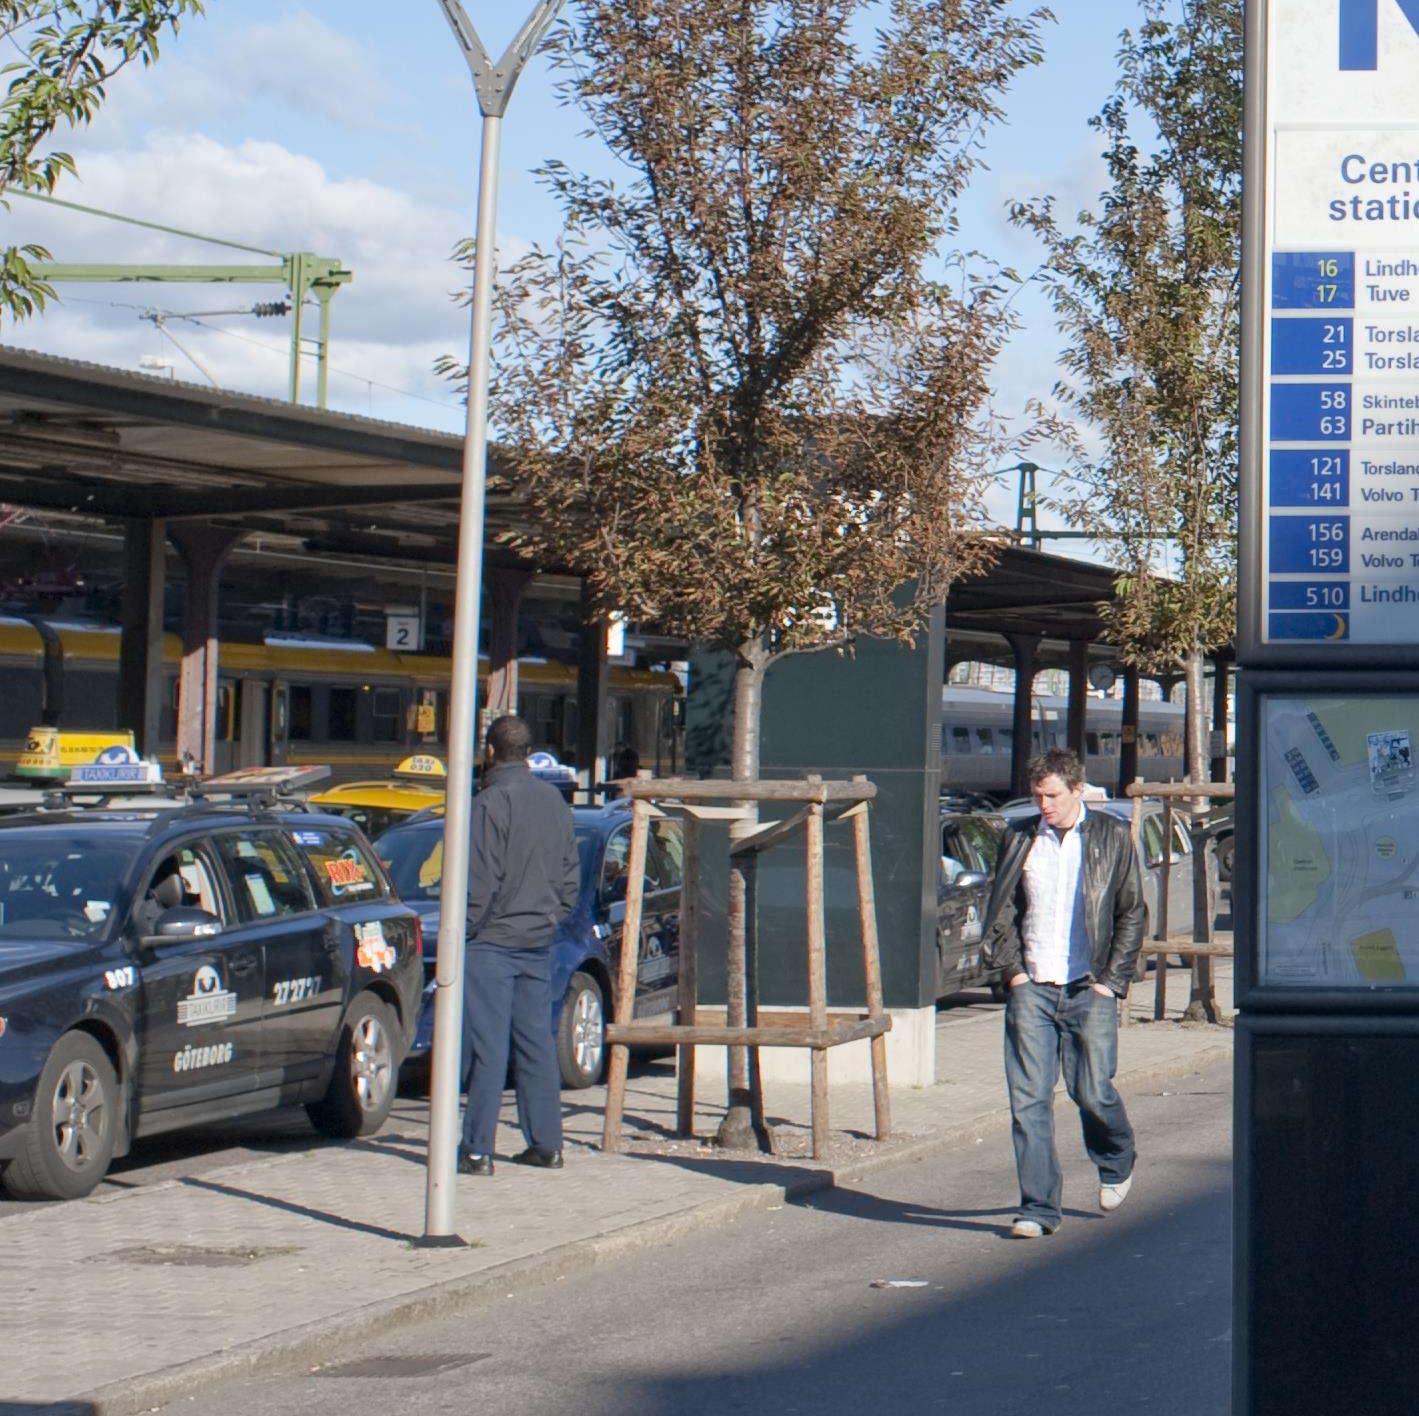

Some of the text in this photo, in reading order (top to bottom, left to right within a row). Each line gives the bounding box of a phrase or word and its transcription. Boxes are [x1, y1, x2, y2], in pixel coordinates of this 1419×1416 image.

[1318, 259, 1338, 277] 16
[1317, 285, 1410, 302] 17 Tuve
[1324, 326, 1345, 343] 21
[1322, 352, 1346, 368] 25
[1320, 392, 1346, 409] 58
[1320, 417, 1345, 435] 63
[1311, 458, 1341, 475] 121
[1311, 483, 1341, 500] 141
[1362, 488, 1403, 502] Volvo
[1309, 524, 1343, 541] 156
[1309, 549, 1343, 567] 159
[1362, 554, 1404, 568] Volvo
[1306, 588, 1344, 606] 510
[396, 628, 409, 645] 2
[104, 966, 136, 991] 807
[273, 981, 288, 1006] 27
[289, 978, 305, 1003] 27
[173, 1042, 233, 1073] GÖTEBORG
